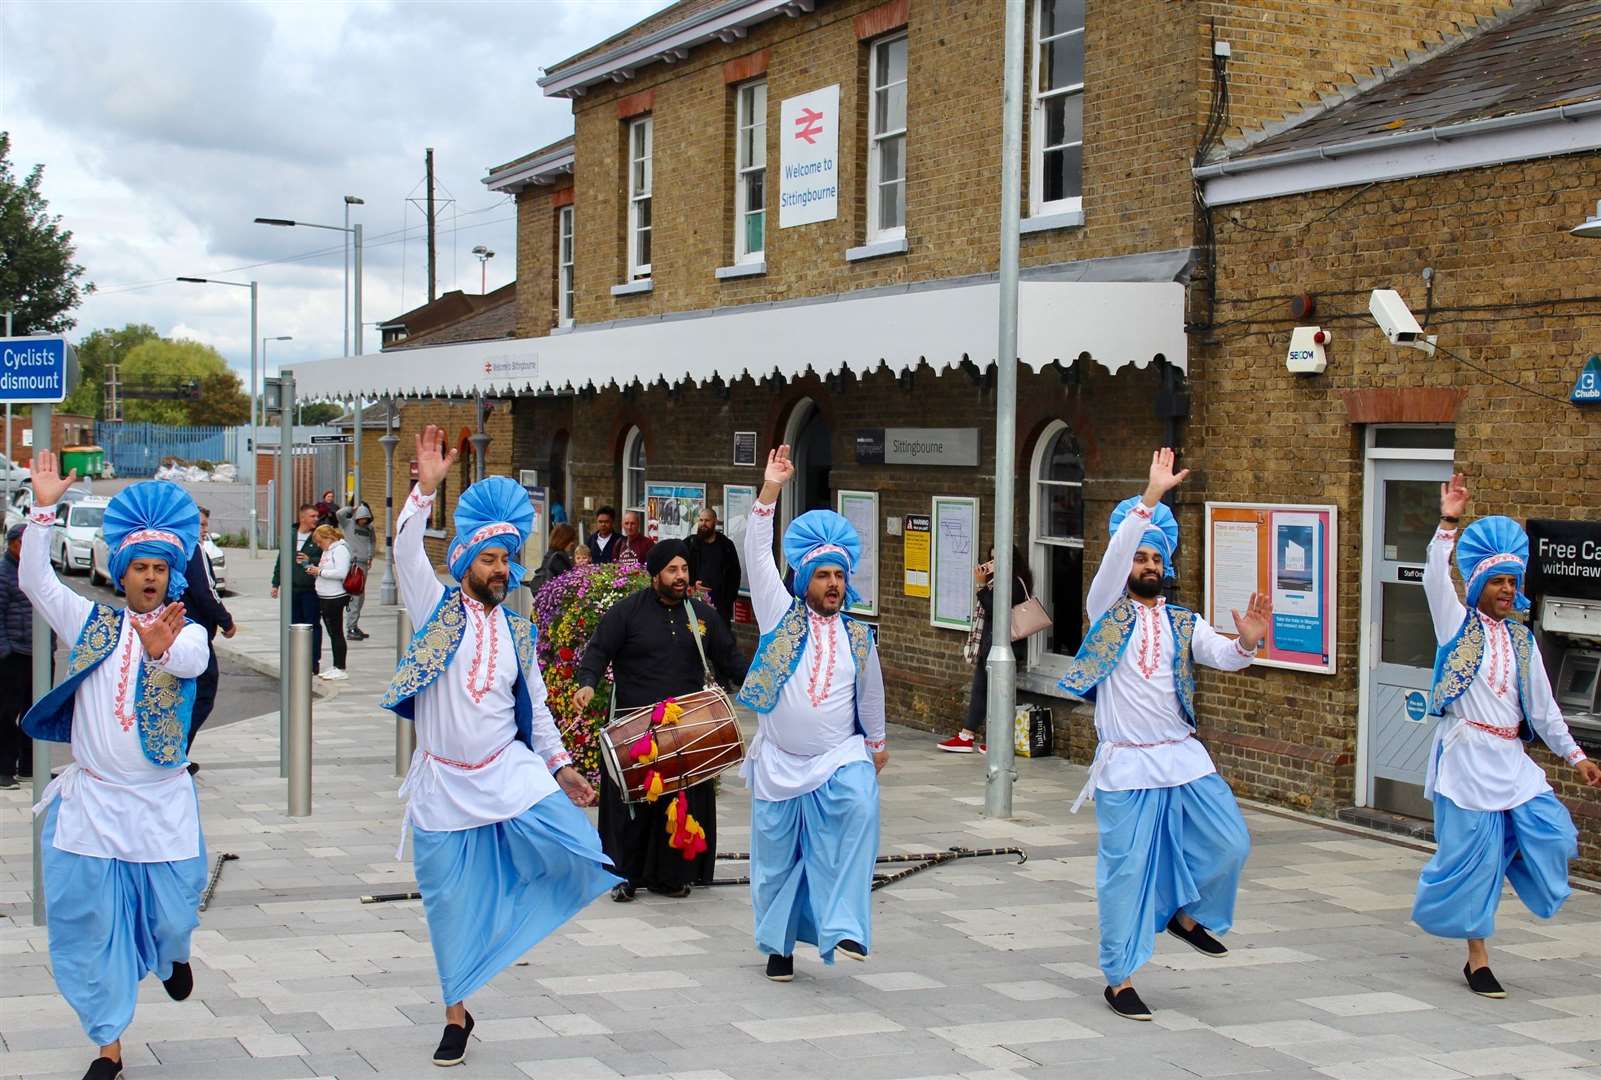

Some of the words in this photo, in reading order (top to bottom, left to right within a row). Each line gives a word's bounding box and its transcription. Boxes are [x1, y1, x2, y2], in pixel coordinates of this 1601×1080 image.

[785, 161, 822, 179] Welcome
[823, 157, 833, 171] to
[781, 186, 836, 208] Sittingbourne
[4, 348, 55, 370] Cyclists
[1290, 350, 1314, 360] SECOM
[0, 371, 59, 390] dismount
[1575, 390, 1600, 398] Chubb
[893, 440, 943, 456] Sittingbourne
[1539, 538, 1577, 559] Free
[1404, 569, 1415, 577] Staff
[1542, 561, 1601, 578] withdraw
